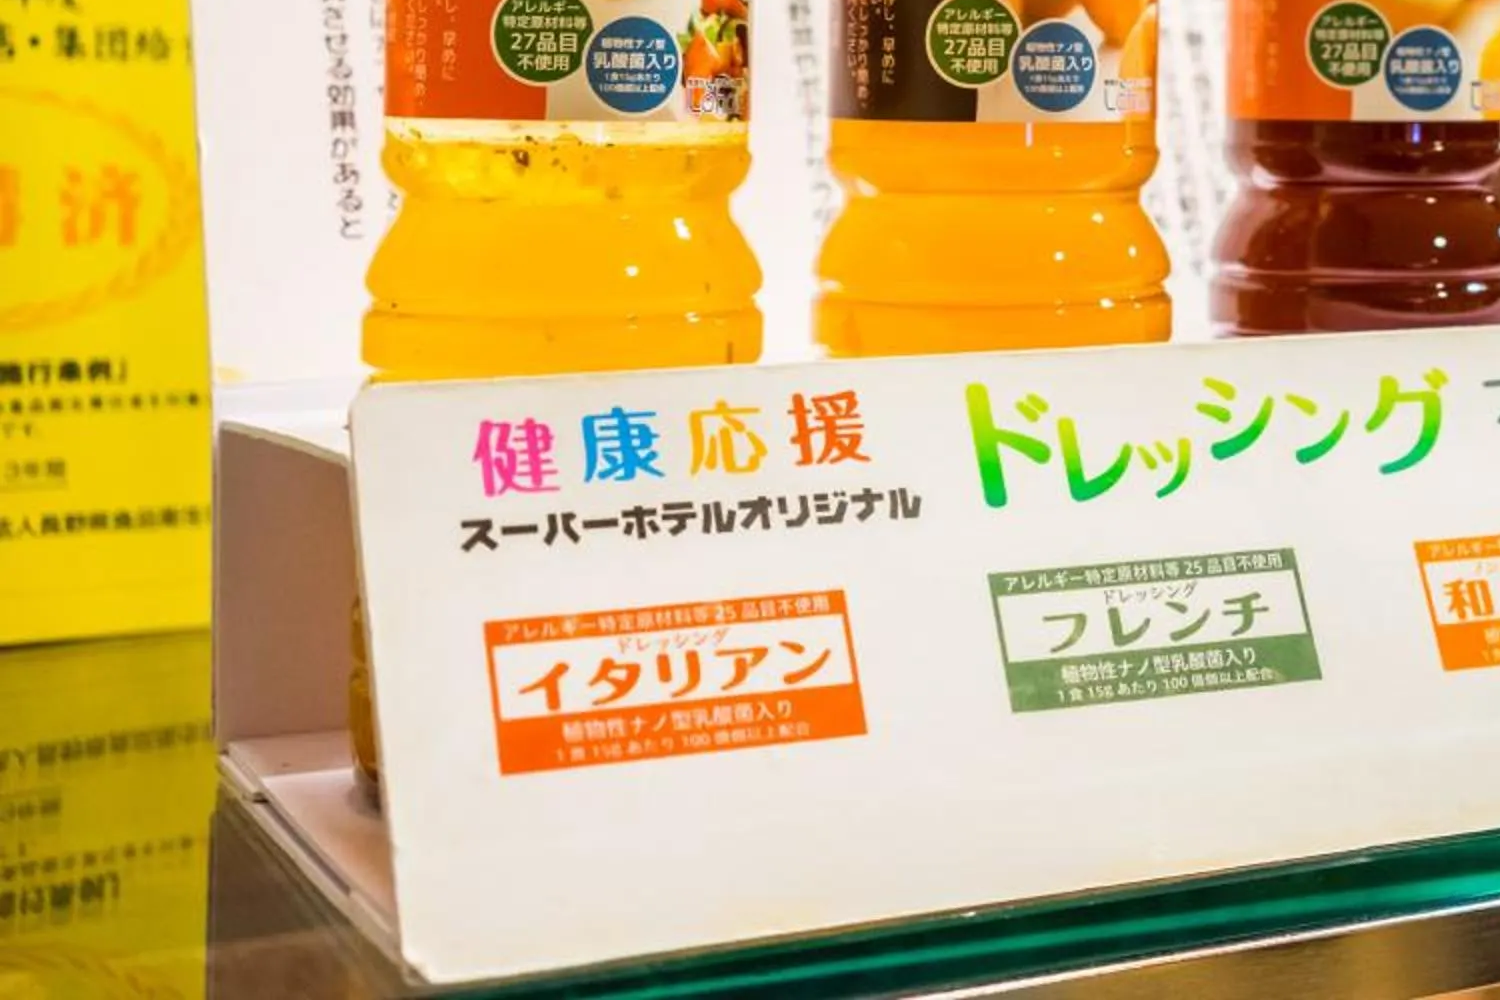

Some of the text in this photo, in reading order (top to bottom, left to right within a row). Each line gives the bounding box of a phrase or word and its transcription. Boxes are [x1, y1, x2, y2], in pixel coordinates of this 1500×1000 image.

[511, 0, 581, 14] アレルギー
[943, 7, 1007, 21] アレルギー
[509, 31, 579, 54] 27品目
[942, 37, 1006, 58] 27品目
[516, 53, 571, 72] 不使用
[592, 52, 677, 70] 乳酸菌入り
[949, 57, 999, 75] 不使用
[1018, 54, 1094, 72] 乳酸菌入り
[471, 390, 872, 498] 健康応援
[964, 367, 1450, 509] ドレッシング
[458, 486, 922, 553] スーパーホテルオリジナル
[1042, 591, 1270, 654] フレンチ
[518, 640, 831, 711] イタリアン
